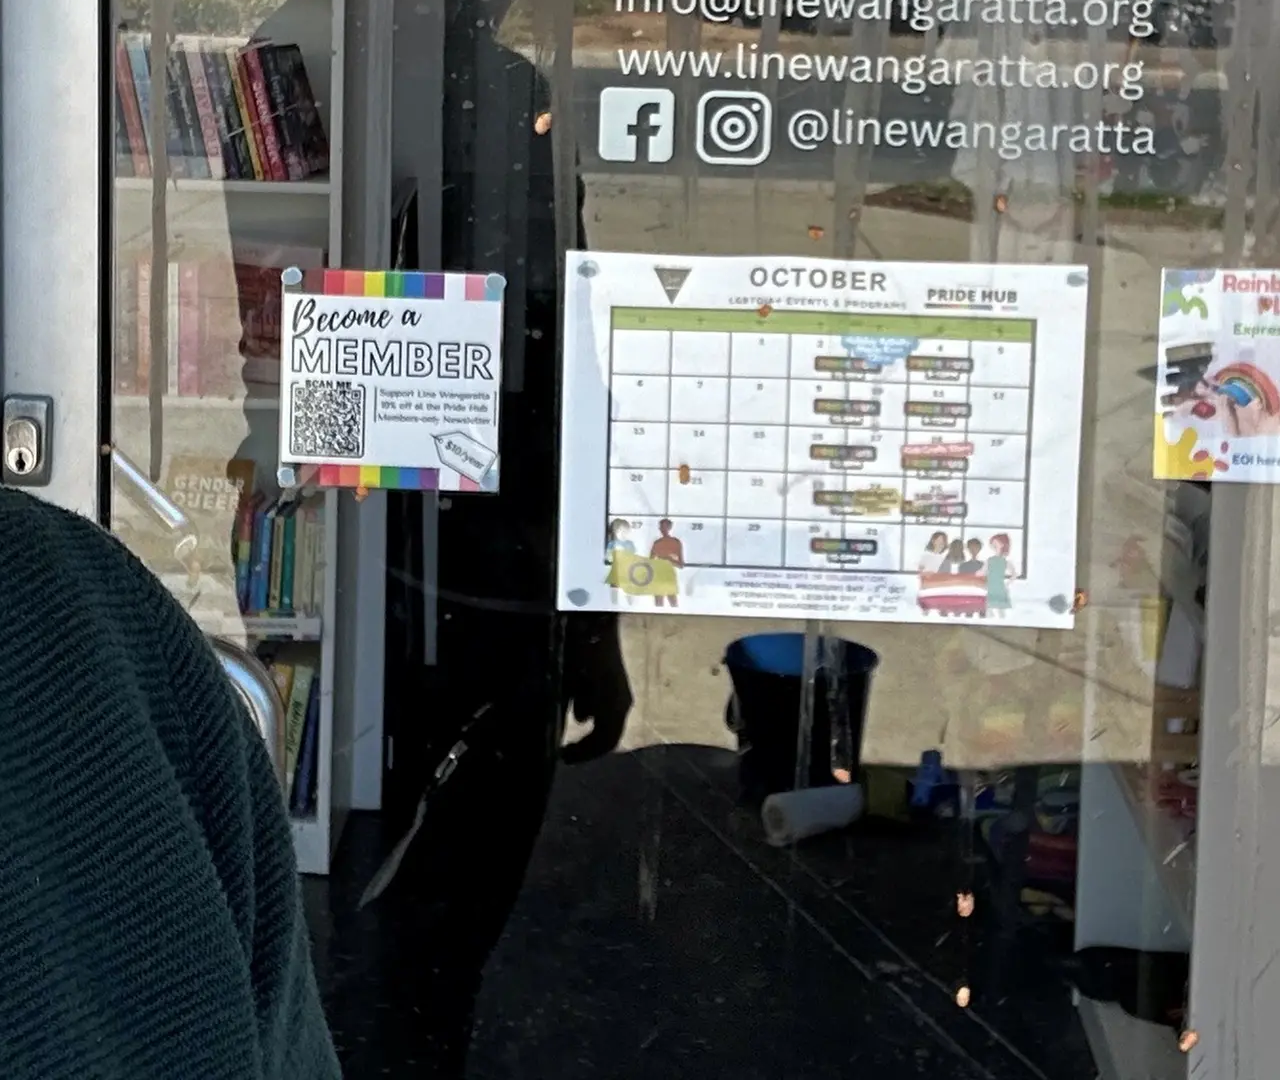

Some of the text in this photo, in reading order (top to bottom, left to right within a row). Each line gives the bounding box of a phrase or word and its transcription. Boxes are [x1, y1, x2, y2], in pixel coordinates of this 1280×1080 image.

[618, 42, 1145, 100] www.linewangaratta.org
[788, 108, 1157, 159] @linewangaratta
[749, 266, 886, 291] OCTOBER
[927, 288, 1018, 303] PRIDE HUB
[292, 298, 422, 338] Become a
[291, 337, 494, 380] MEMBER
[305, 380, 352, 390] SCAN ME
[171, 476, 245, 511] GENDER QUEER
